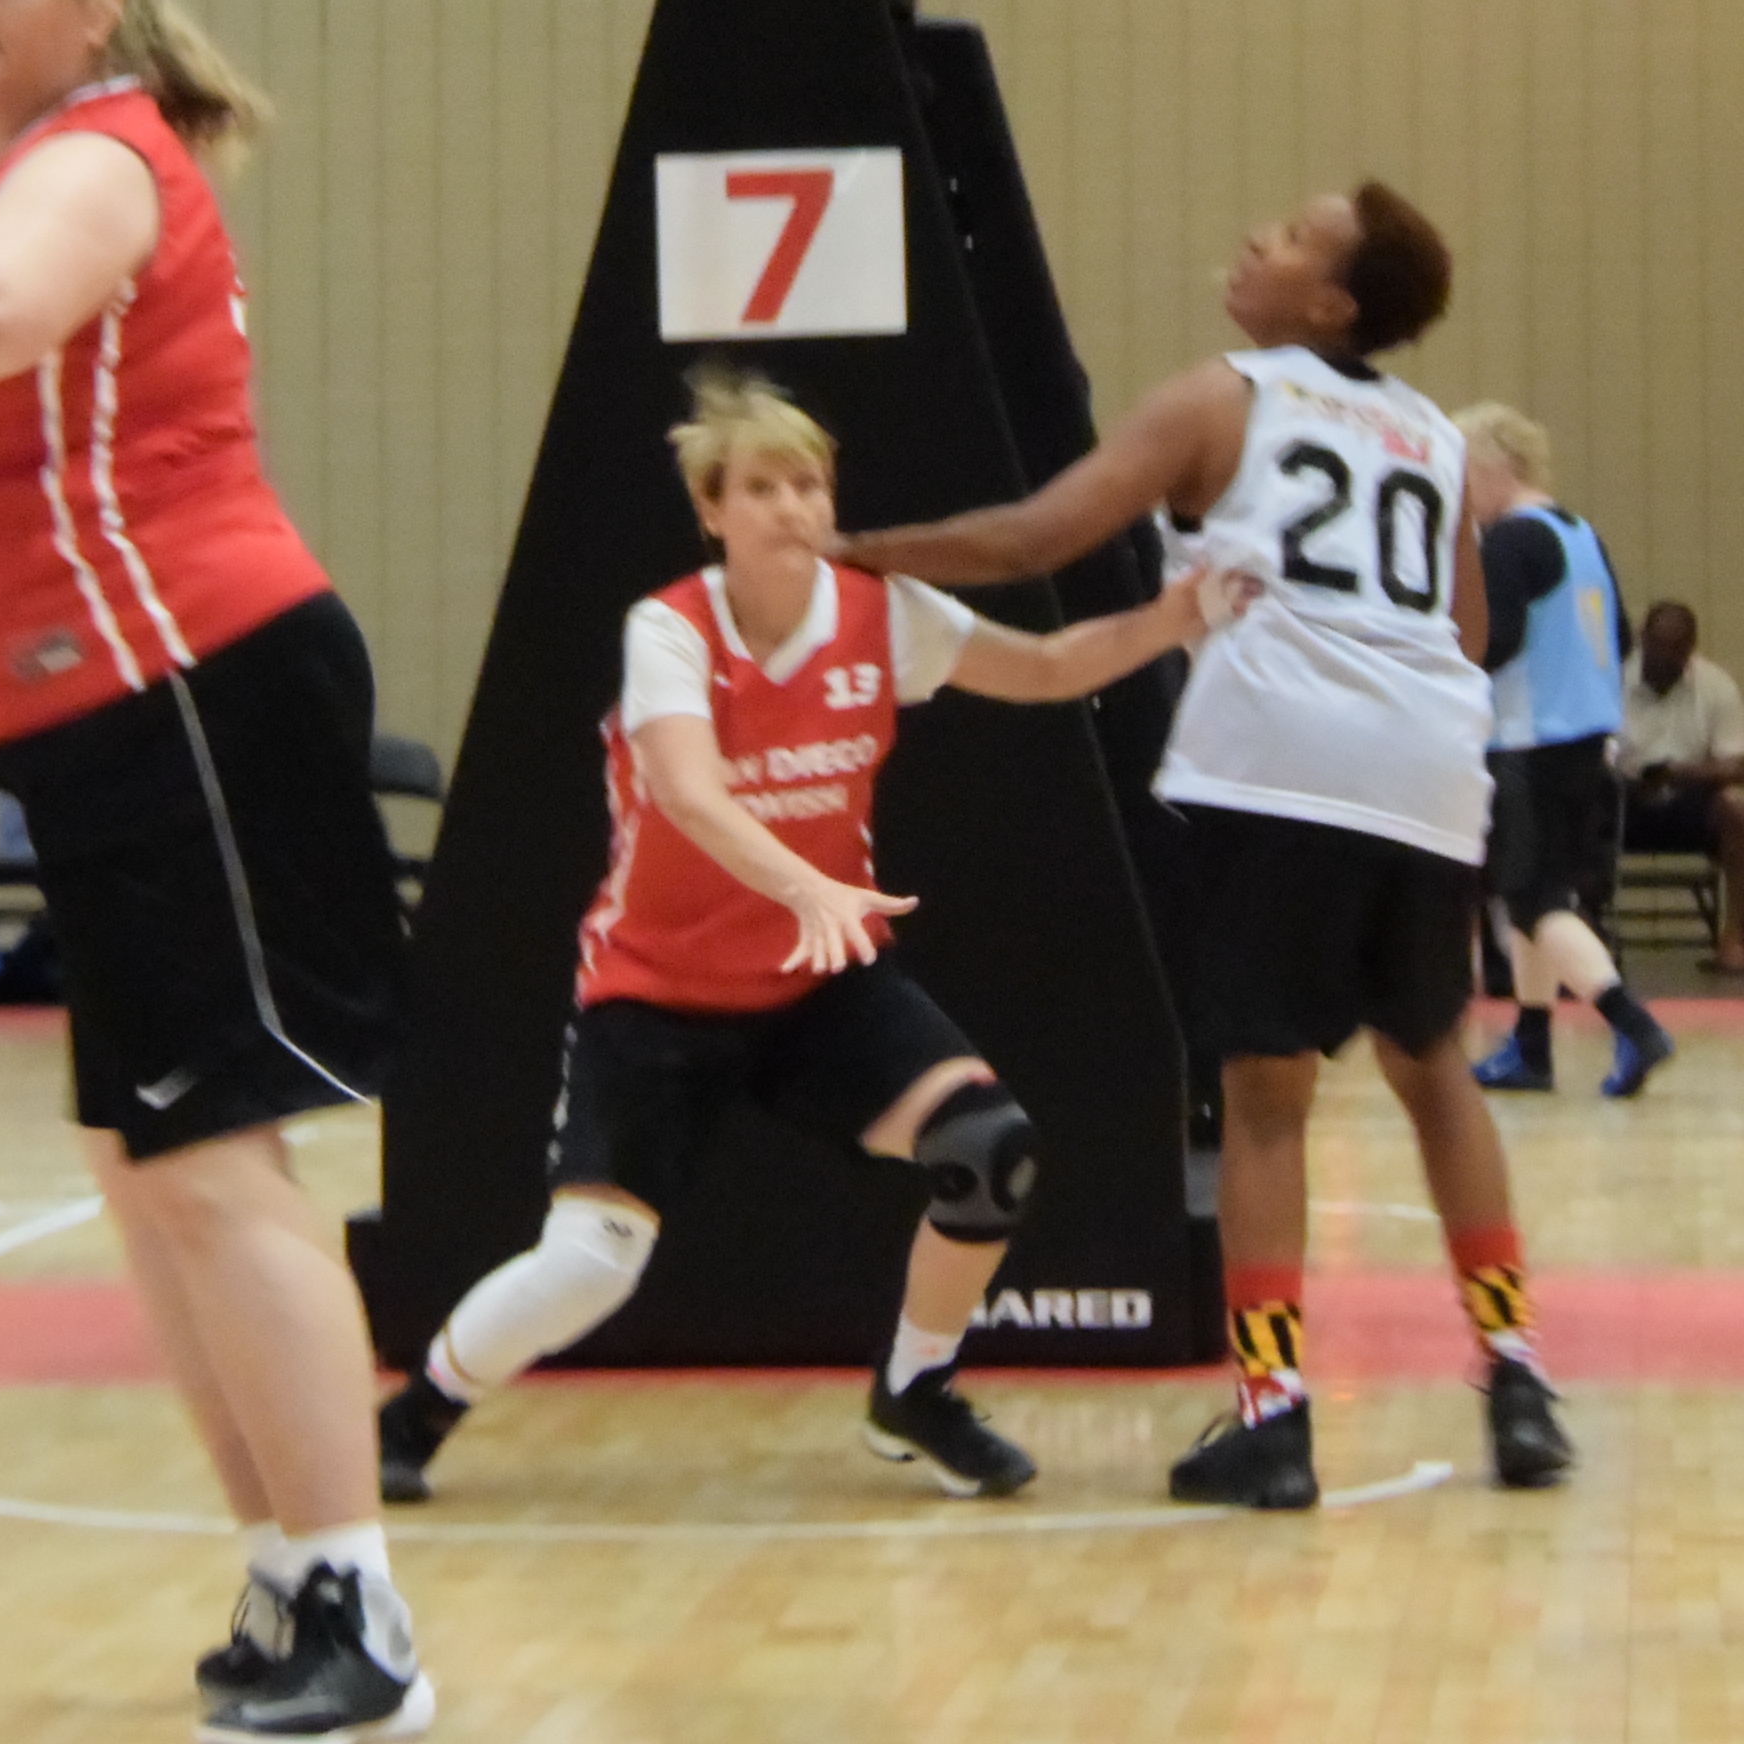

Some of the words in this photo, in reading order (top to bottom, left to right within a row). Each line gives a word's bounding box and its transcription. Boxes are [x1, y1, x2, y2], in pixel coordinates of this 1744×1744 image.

[725, 167, 835, 325] 7
[1278, 439, 1444, 614] 20
[822, 662, 883, 710] 13
[969, 1287, 1153, 1329] ARED
